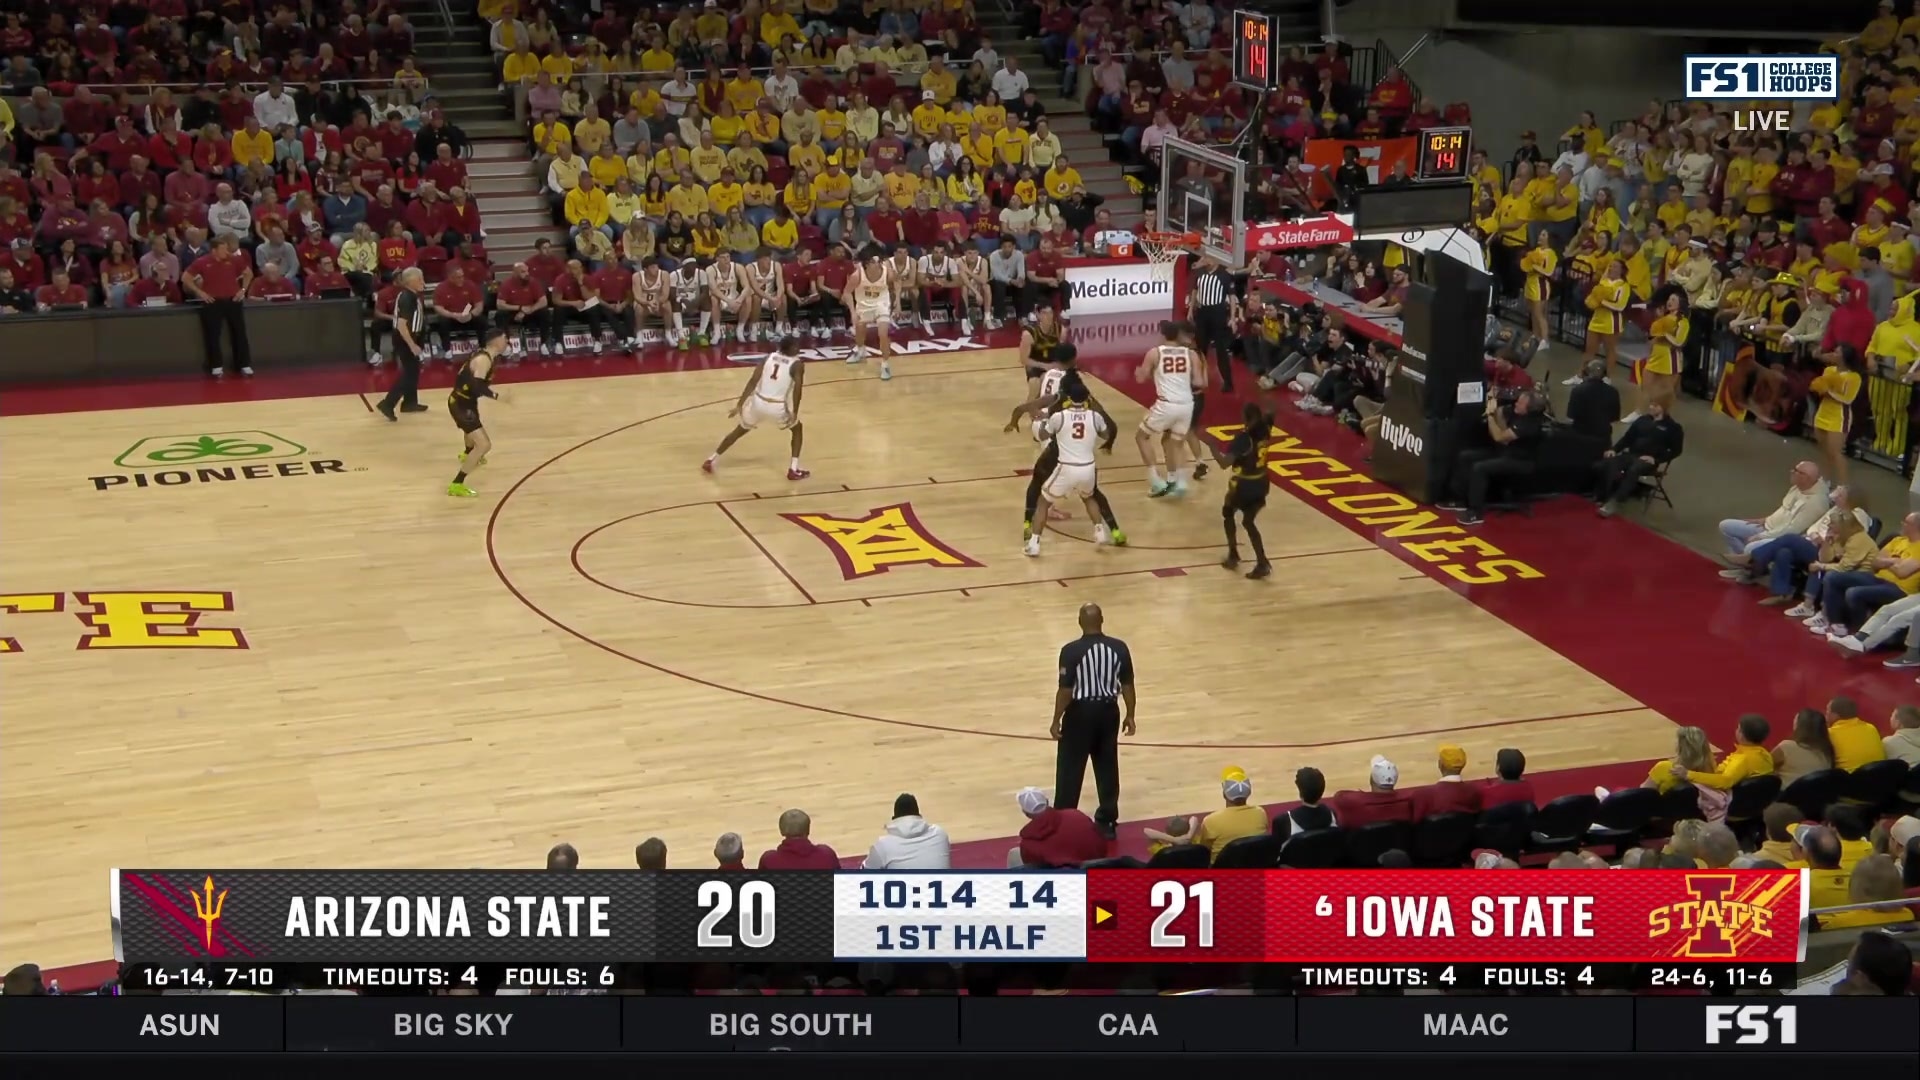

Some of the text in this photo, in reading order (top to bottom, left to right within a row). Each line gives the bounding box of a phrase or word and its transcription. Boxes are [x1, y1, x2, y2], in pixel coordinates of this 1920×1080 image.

[1244, 20, 1267, 41] 10:14
[1249, 44, 1266, 78] 14
[1430, 136, 1462, 150] 10:14
[1436, 153, 1454, 169] 14
[1071, 278, 1168, 299] Mediacom
[770, 363, 780, 380] 1
[1163, 356, 1186, 373] 22
[1072, 422, 1085, 439] 3
[1380, 415, 1423, 456] HyVee
[88, 459, 348, 490] PIONEER
